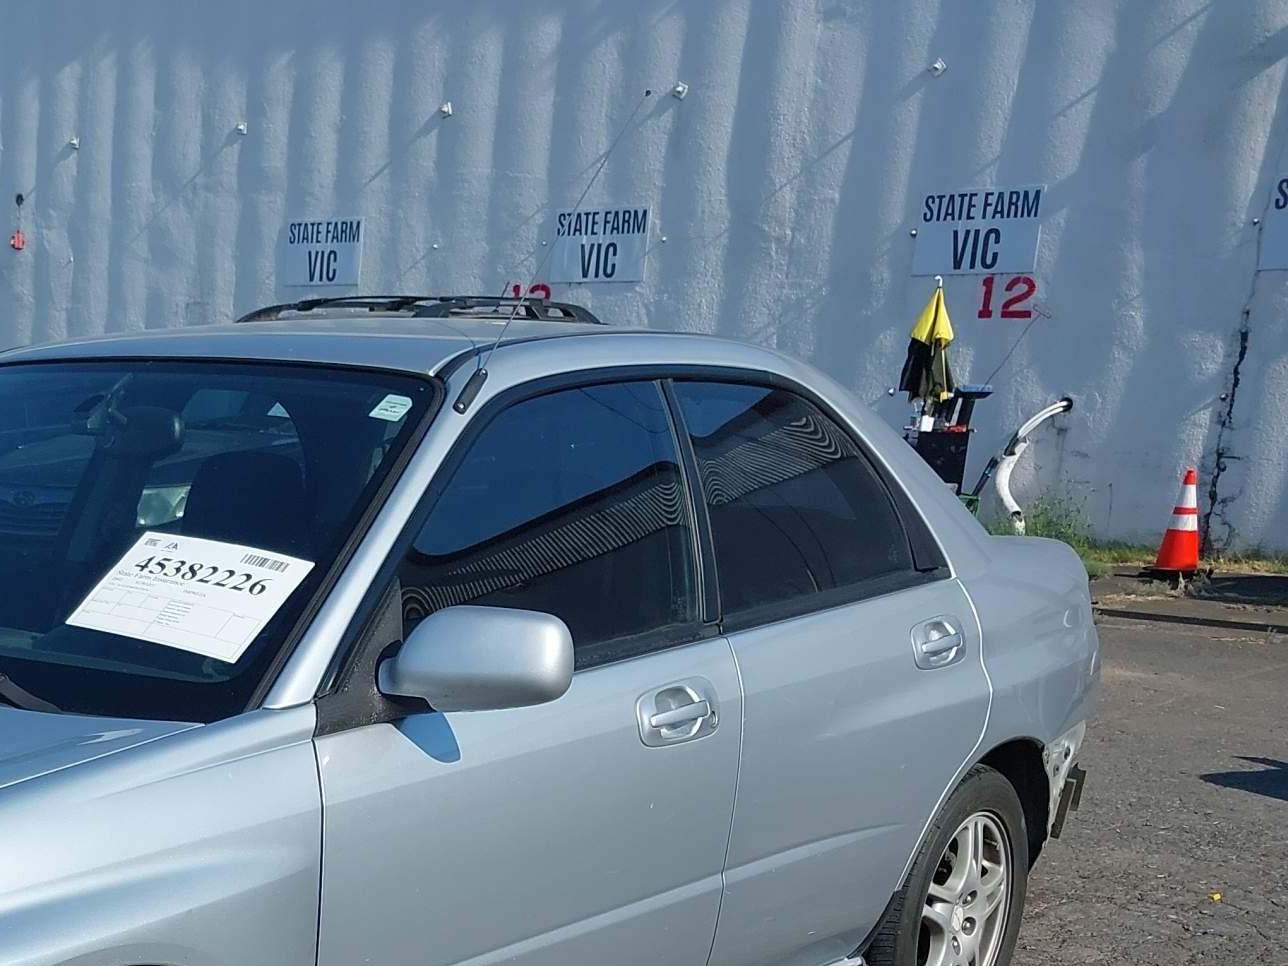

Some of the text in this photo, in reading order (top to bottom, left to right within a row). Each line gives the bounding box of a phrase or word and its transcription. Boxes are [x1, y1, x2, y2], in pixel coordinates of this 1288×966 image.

[557, 208, 648, 237] STATE FARM
[923, 189, 1042, 223] STATE FARM
[288, 220, 361, 245] STATE FARM
[952, 228, 1001, 270] VIC
[307, 249, 338, 282] VIC
[580, 241, 618, 279] VIC
[977, 276, 1037, 319] 12
[134, 555, 273, 597] 45382226
